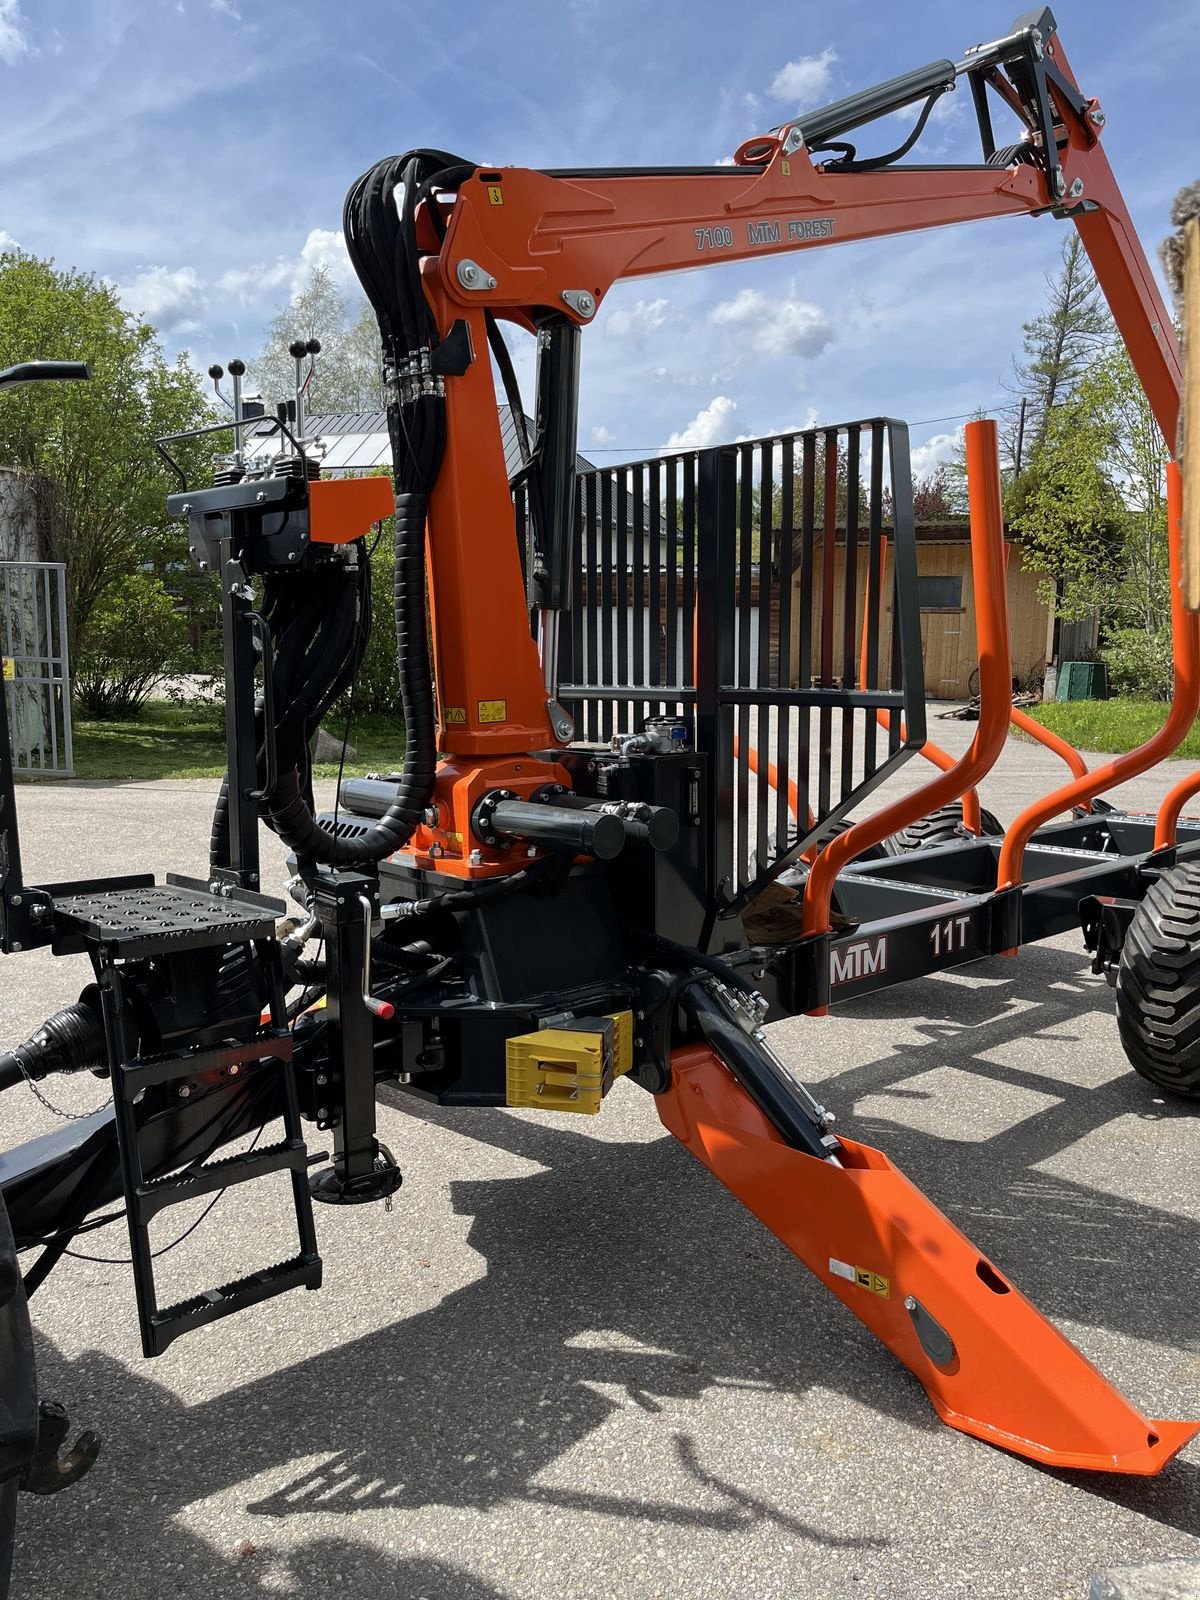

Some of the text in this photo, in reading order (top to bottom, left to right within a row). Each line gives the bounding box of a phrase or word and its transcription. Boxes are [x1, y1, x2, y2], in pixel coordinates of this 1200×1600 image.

[695, 218, 836, 250] 7100 MTM FOREST
[830, 915, 971, 986] MTM 11T
